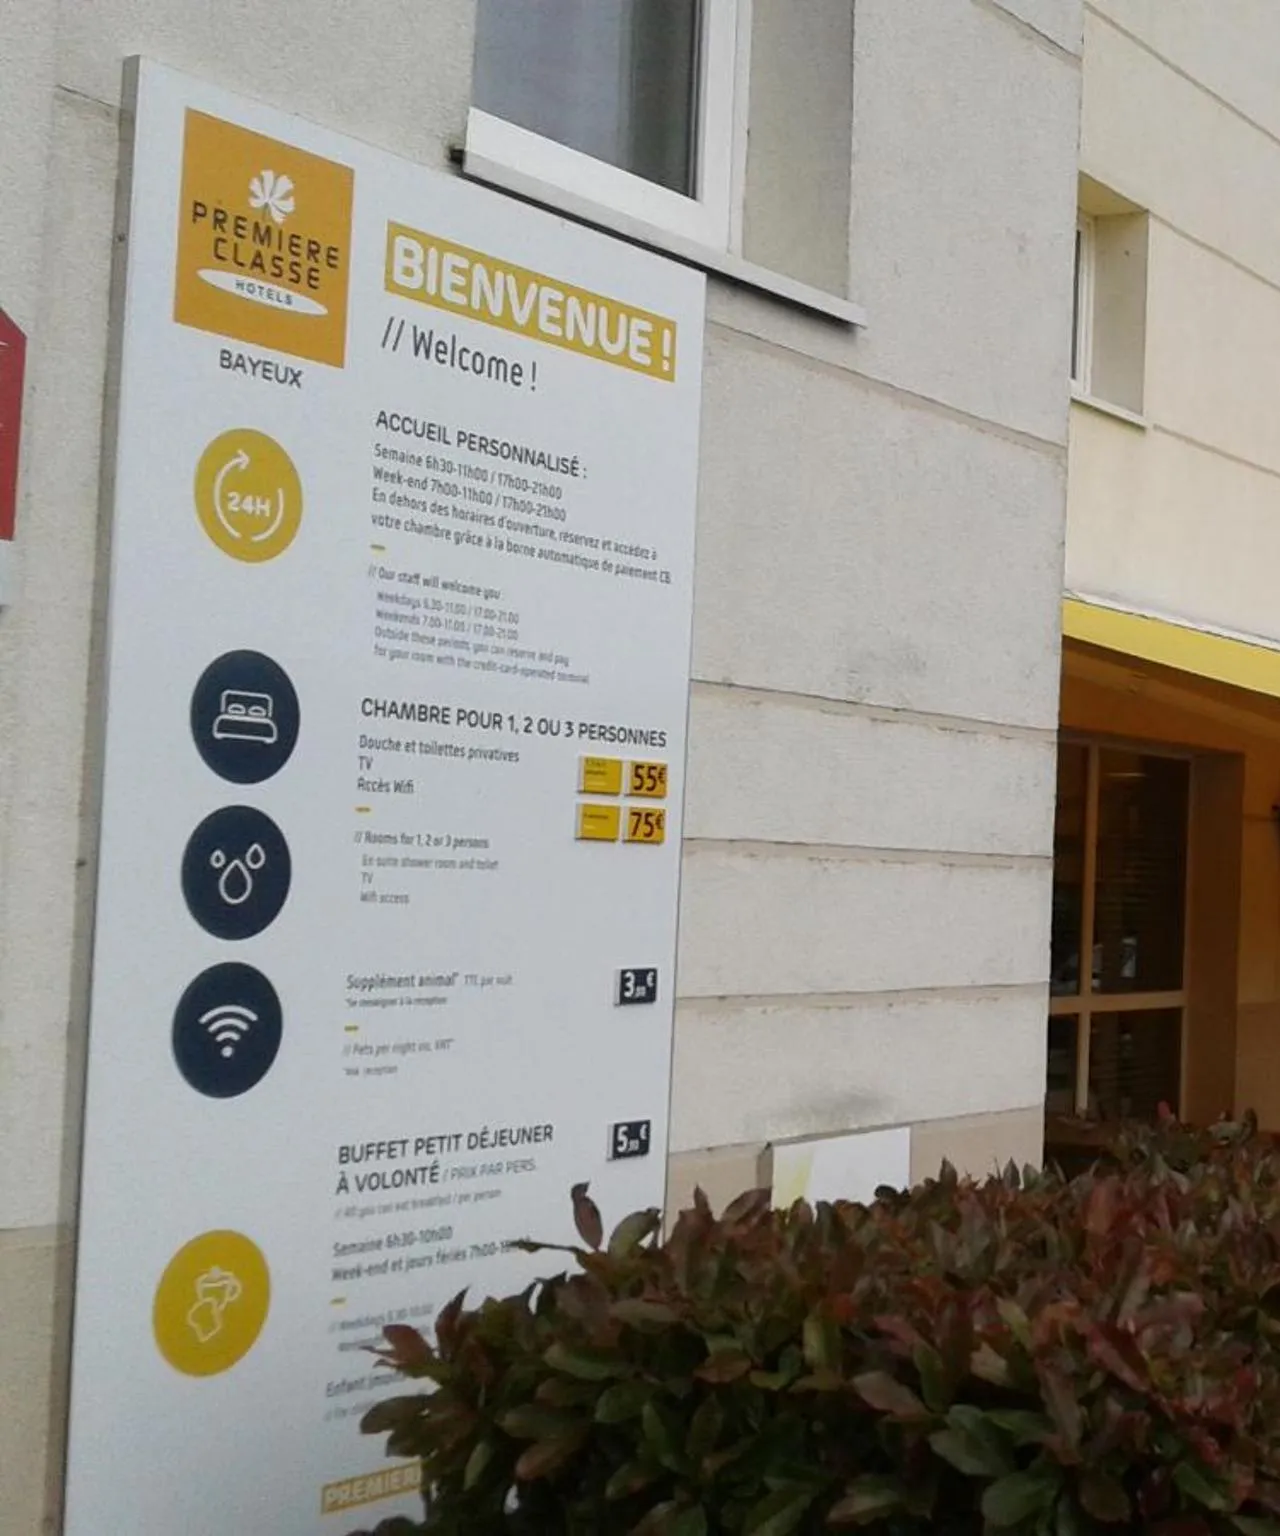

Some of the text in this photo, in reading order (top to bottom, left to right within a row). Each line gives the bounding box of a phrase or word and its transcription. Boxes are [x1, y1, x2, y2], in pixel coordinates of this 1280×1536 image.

[191, 200, 340, 269] PREMIERE
[212, 237, 321, 290] CLASSE
[235, 279, 293, 306] HOTELS
[391, 235, 655, 367] BIENVENUE
[219, 348, 303, 388] BAYEUX
[412, 324, 524, 387] Welcome
[375, 410, 452, 446] ACCUEIL
[457, 430, 580, 477] PERSONNALISÉ
[374, 443, 423, 467] Semaine
[426, 455, 488, 483] 6h30-11h00
[498, 472, 563, 500] 17h00-21h00
[227, 491, 271, 517] 24H
[373, 466, 428, 491] Week-end
[431, 479, 493, 506] 7h00-11h00
[503, 495, 566, 522] 17h00-21h00
[372, 487, 386, 503] En
[389, 491, 427, 513] dehors
[430, 502, 450, 517] des
[452, 505, 496, 527] horaires
[602, 540, 612, 551] et
[371, 514, 401, 530] votre
[404, 518, 451, 541] chambre
[495, 536, 504, 551] la
[507, 538, 536, 558] borne
[538, 548, 600, 571] automatique
[602, 560, 613, 573] de
[398, 571, 421, 586] staff
[441, 579, 482, 597] welcome
[361, 697, 667, 748] CHAMBRE POUR 1, 2 OU 3 PERSONNES
[358, 756, 373, 771] TV
[359, 734, 520, 763] Douche et toilettes privatives
[394, 779, 414, 794] Wifi
[632, 764, 667, 792] 55€
[629, 811, 665, 839] 75€
[361, 872, 374, 884] TV
[346, 973, 415, 993] Supplément
[338, 1124, 554, 1165] BUFFET PETIT DÉJEUNER
[335, 1170, 350, 1195] À
[355, 1160, 440, 1193] VOLONTÉ
[451, 1166, 477, 1180] PRIX
[480, 1162, 504, 1176] PAR
[333, 1239, 382, 1257] Semaine
[332, 1259, 388, 1281] Week-end
[391, 1257, 403, 1272] et
[404, 1255, 433, 1273] jours
